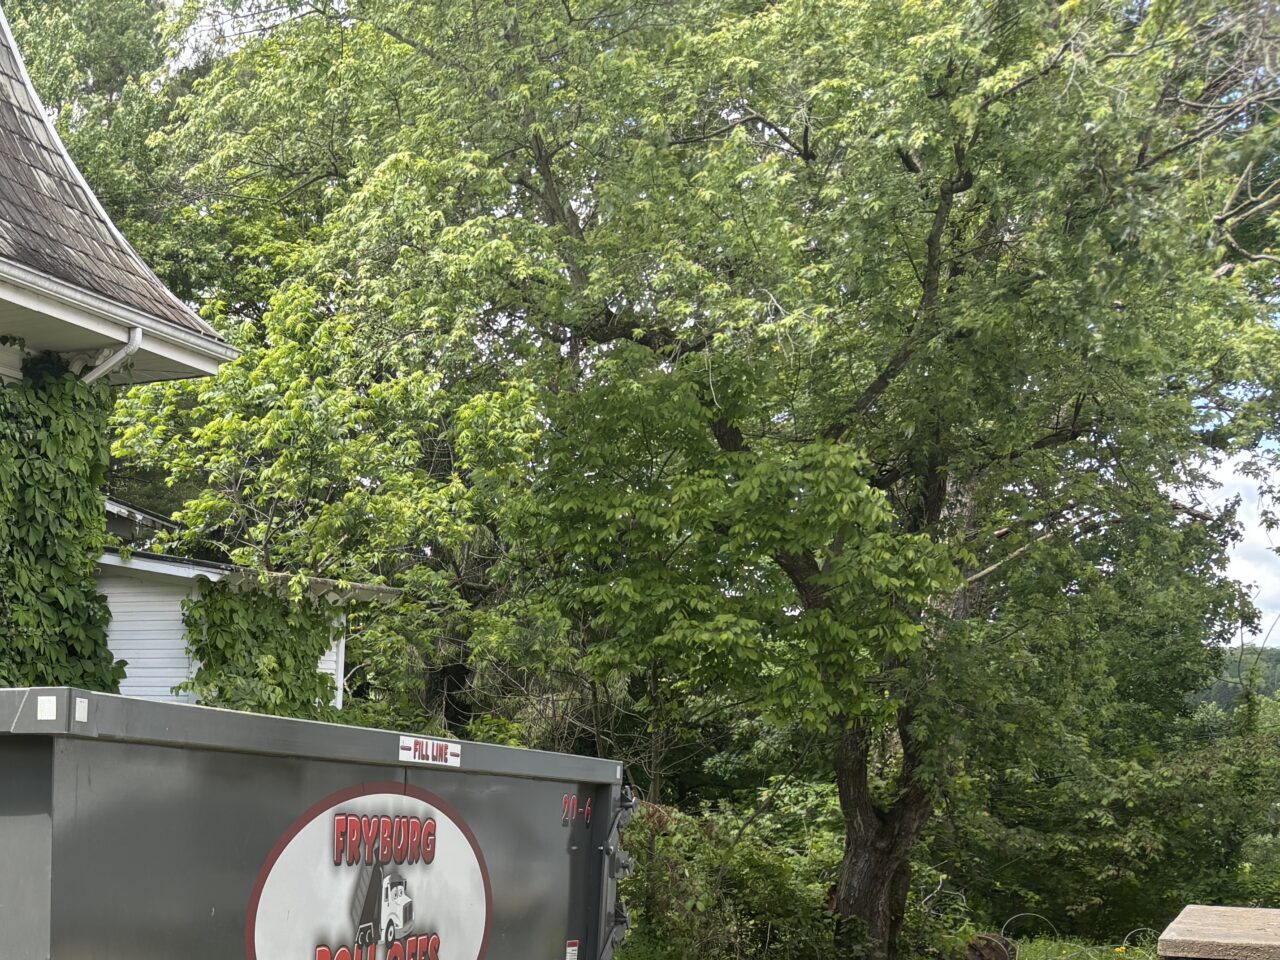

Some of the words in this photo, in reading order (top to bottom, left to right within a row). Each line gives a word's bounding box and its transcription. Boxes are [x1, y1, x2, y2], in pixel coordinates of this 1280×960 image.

[413, 739, 430, 761] FILL
[431, 741, 449, 763] LINE
[333, 812, 437, 867] FRYBURG
